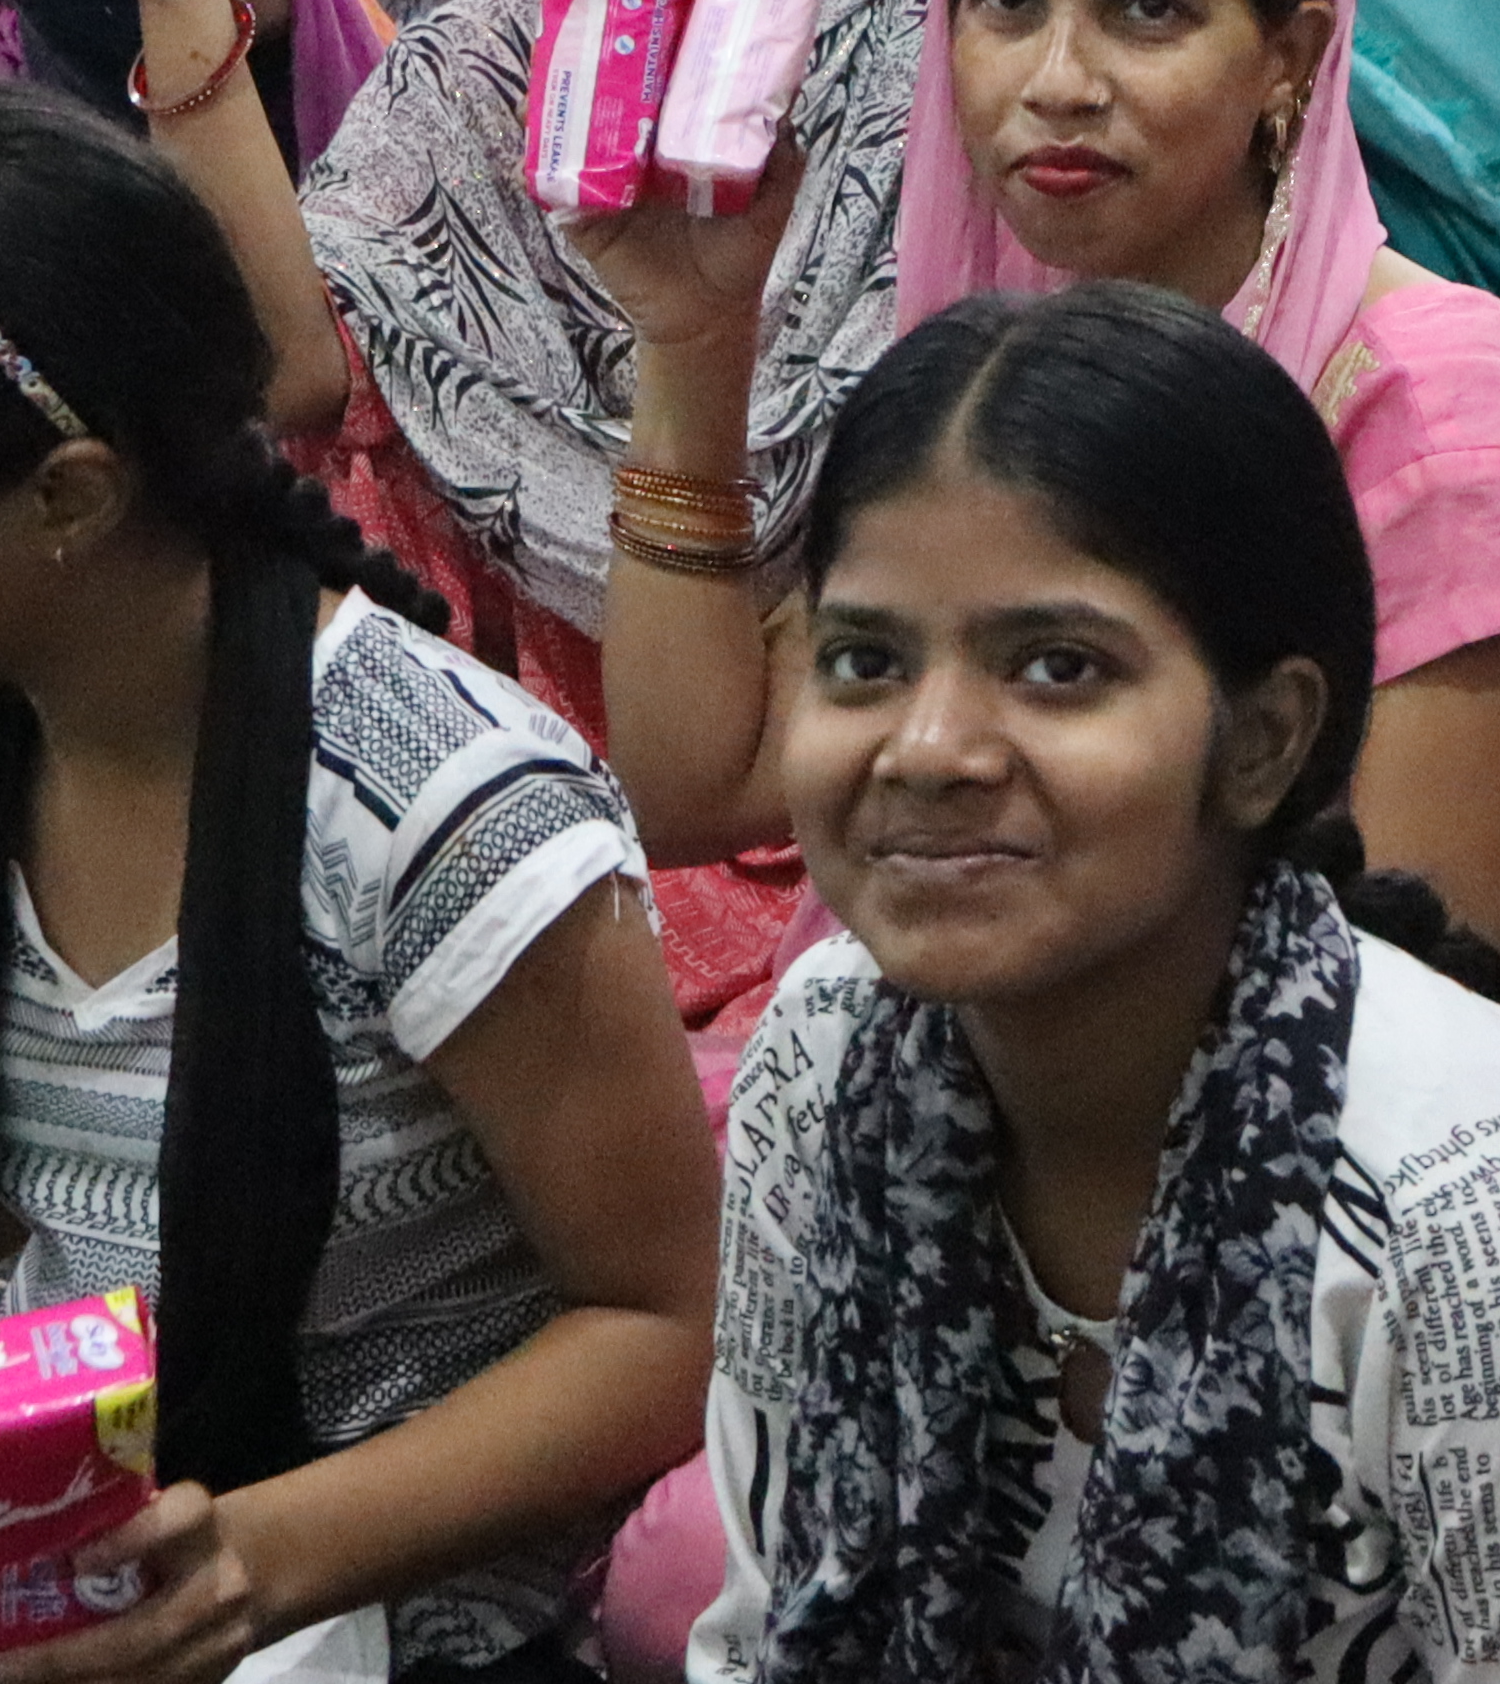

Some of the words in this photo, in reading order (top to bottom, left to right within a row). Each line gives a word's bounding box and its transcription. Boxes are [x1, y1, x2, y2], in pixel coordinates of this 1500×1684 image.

[641, 24, 664, 104] MAINTAINS
[555, 70, 573, 132] PREVENTS
[1460, 1185, 1478, 1205] to
[1402, 1219, 1423, 1254] life
[1426, 1224, 1447, 1256] the
[1470, 1212, 1499, 1267] seens
[1415, 1265, 1448, 1352] different
[1433, 1261, 1468, 1340] reached
[1466, 1299, 1486, 1318] of
[1432, 1363, 1451, 1383] of
[1454, 1346, 1474, 1379] has
[1474, 1322, 1500, 1420] beginning
[1440, 1394, 1457, 1421] lot
[1460, 1384, 1482, 1420] Age
[1476, 1454, 1491, 1474] to
[1478, 1482, 1498, 1535] seens
[1483, 1542, 1500, 1571] his
